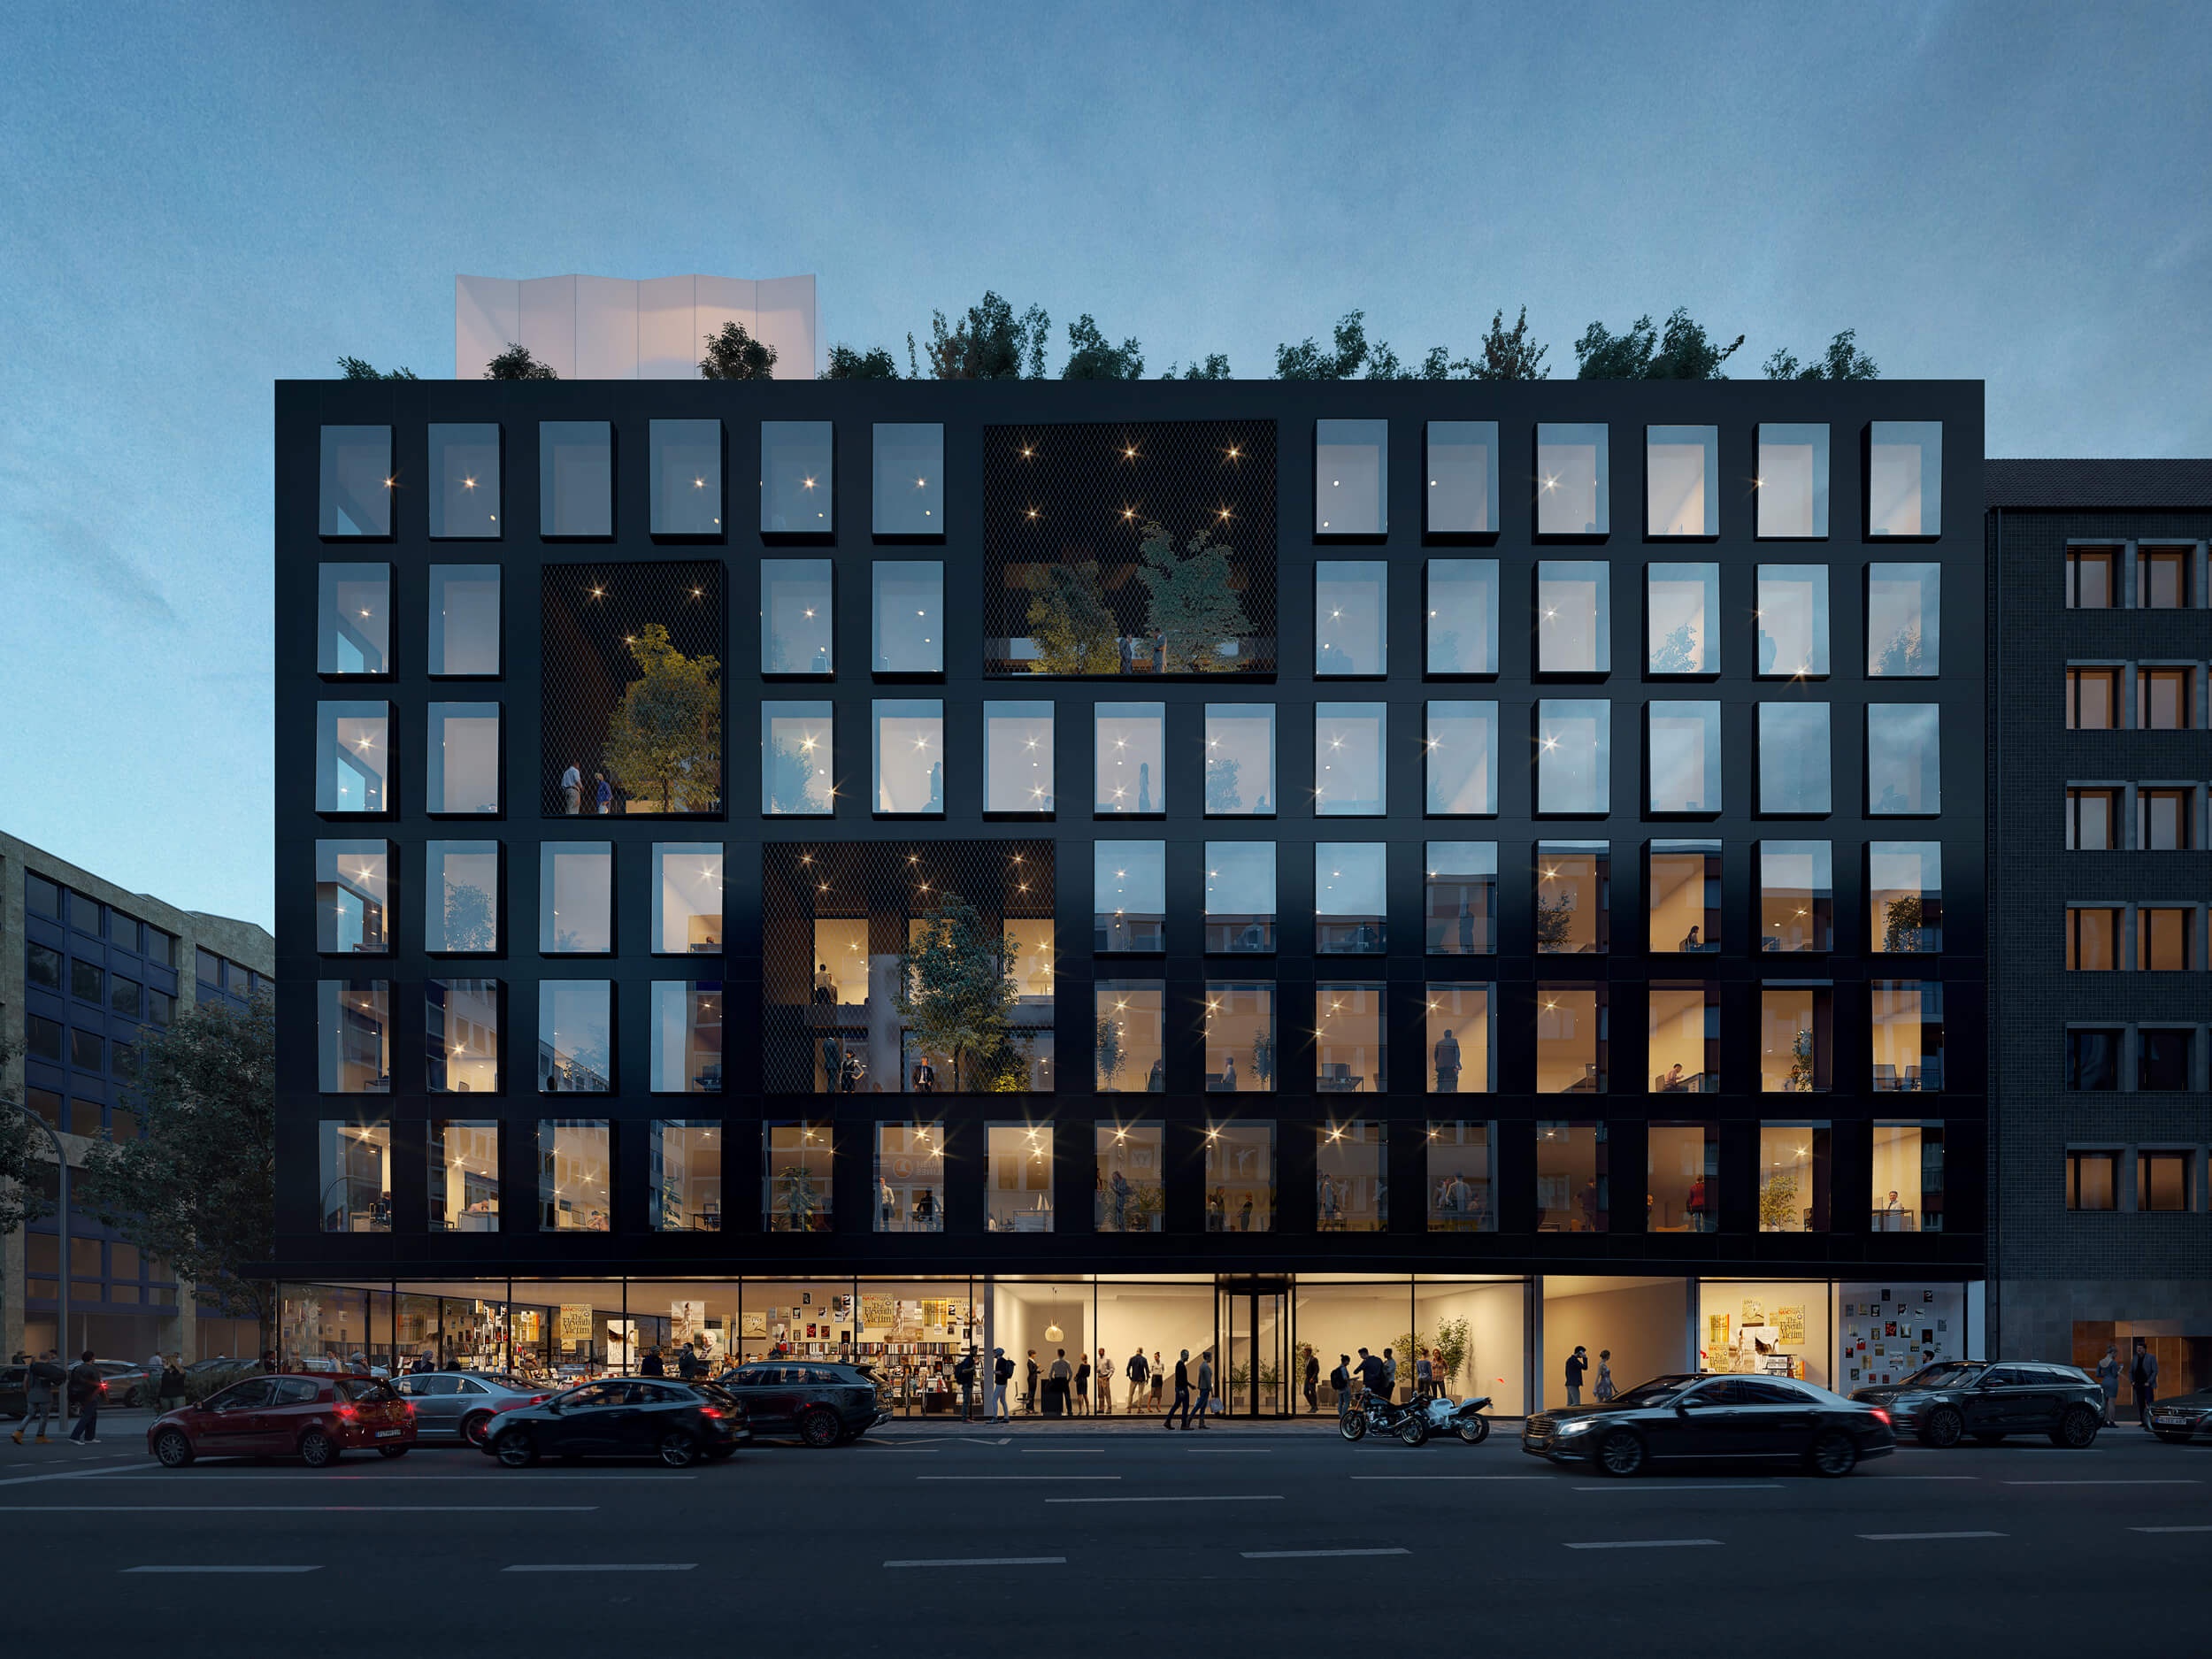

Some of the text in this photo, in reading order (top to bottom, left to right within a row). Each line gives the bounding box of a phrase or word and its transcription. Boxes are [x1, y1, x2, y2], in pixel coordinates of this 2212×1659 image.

[864, 1306, 892, 1315] Eleventh
[563, 1317, 590, 1326] Eleventh
[866, 1314, 891, 1323] Victim
[565, 1325, 590, 1334] Victim
